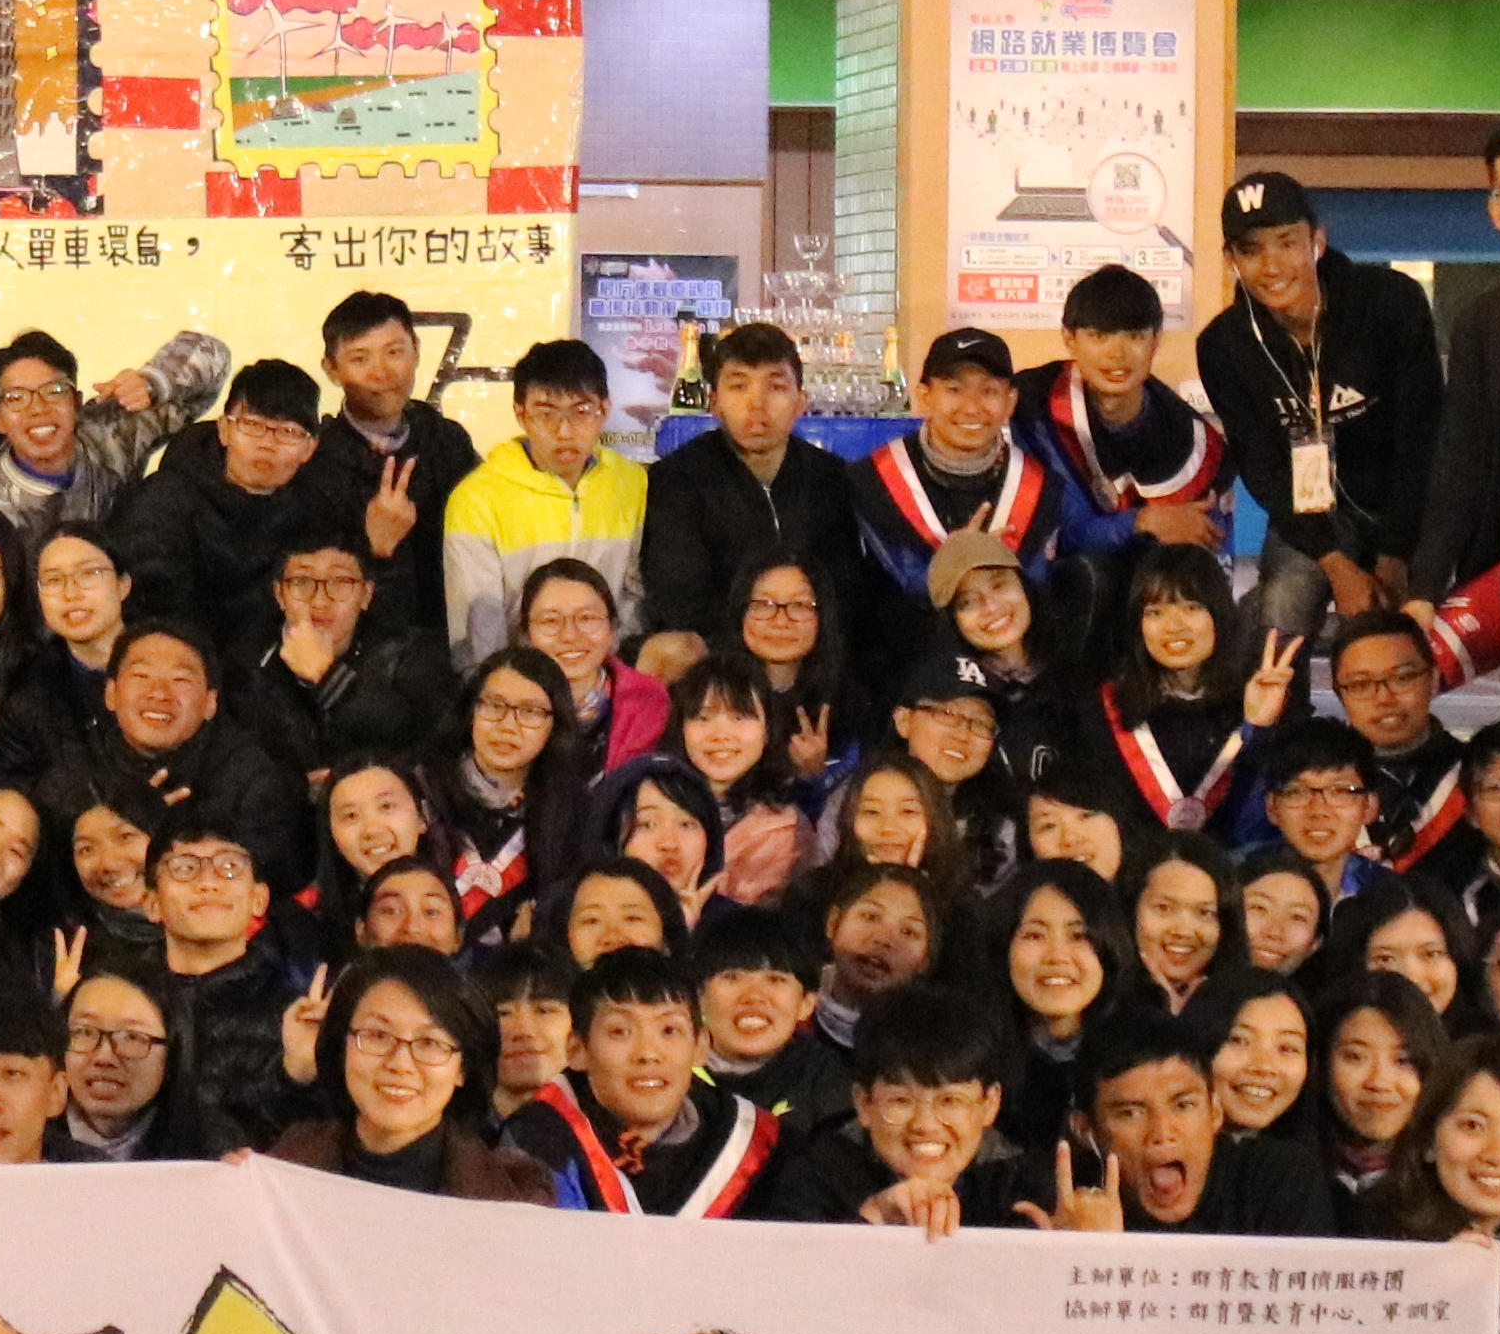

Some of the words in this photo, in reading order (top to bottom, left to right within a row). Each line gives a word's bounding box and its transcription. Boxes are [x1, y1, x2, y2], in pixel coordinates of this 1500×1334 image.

[1237, 183, 1265, 213] W
[279, 222, 557, 271] 寄出你的故事
